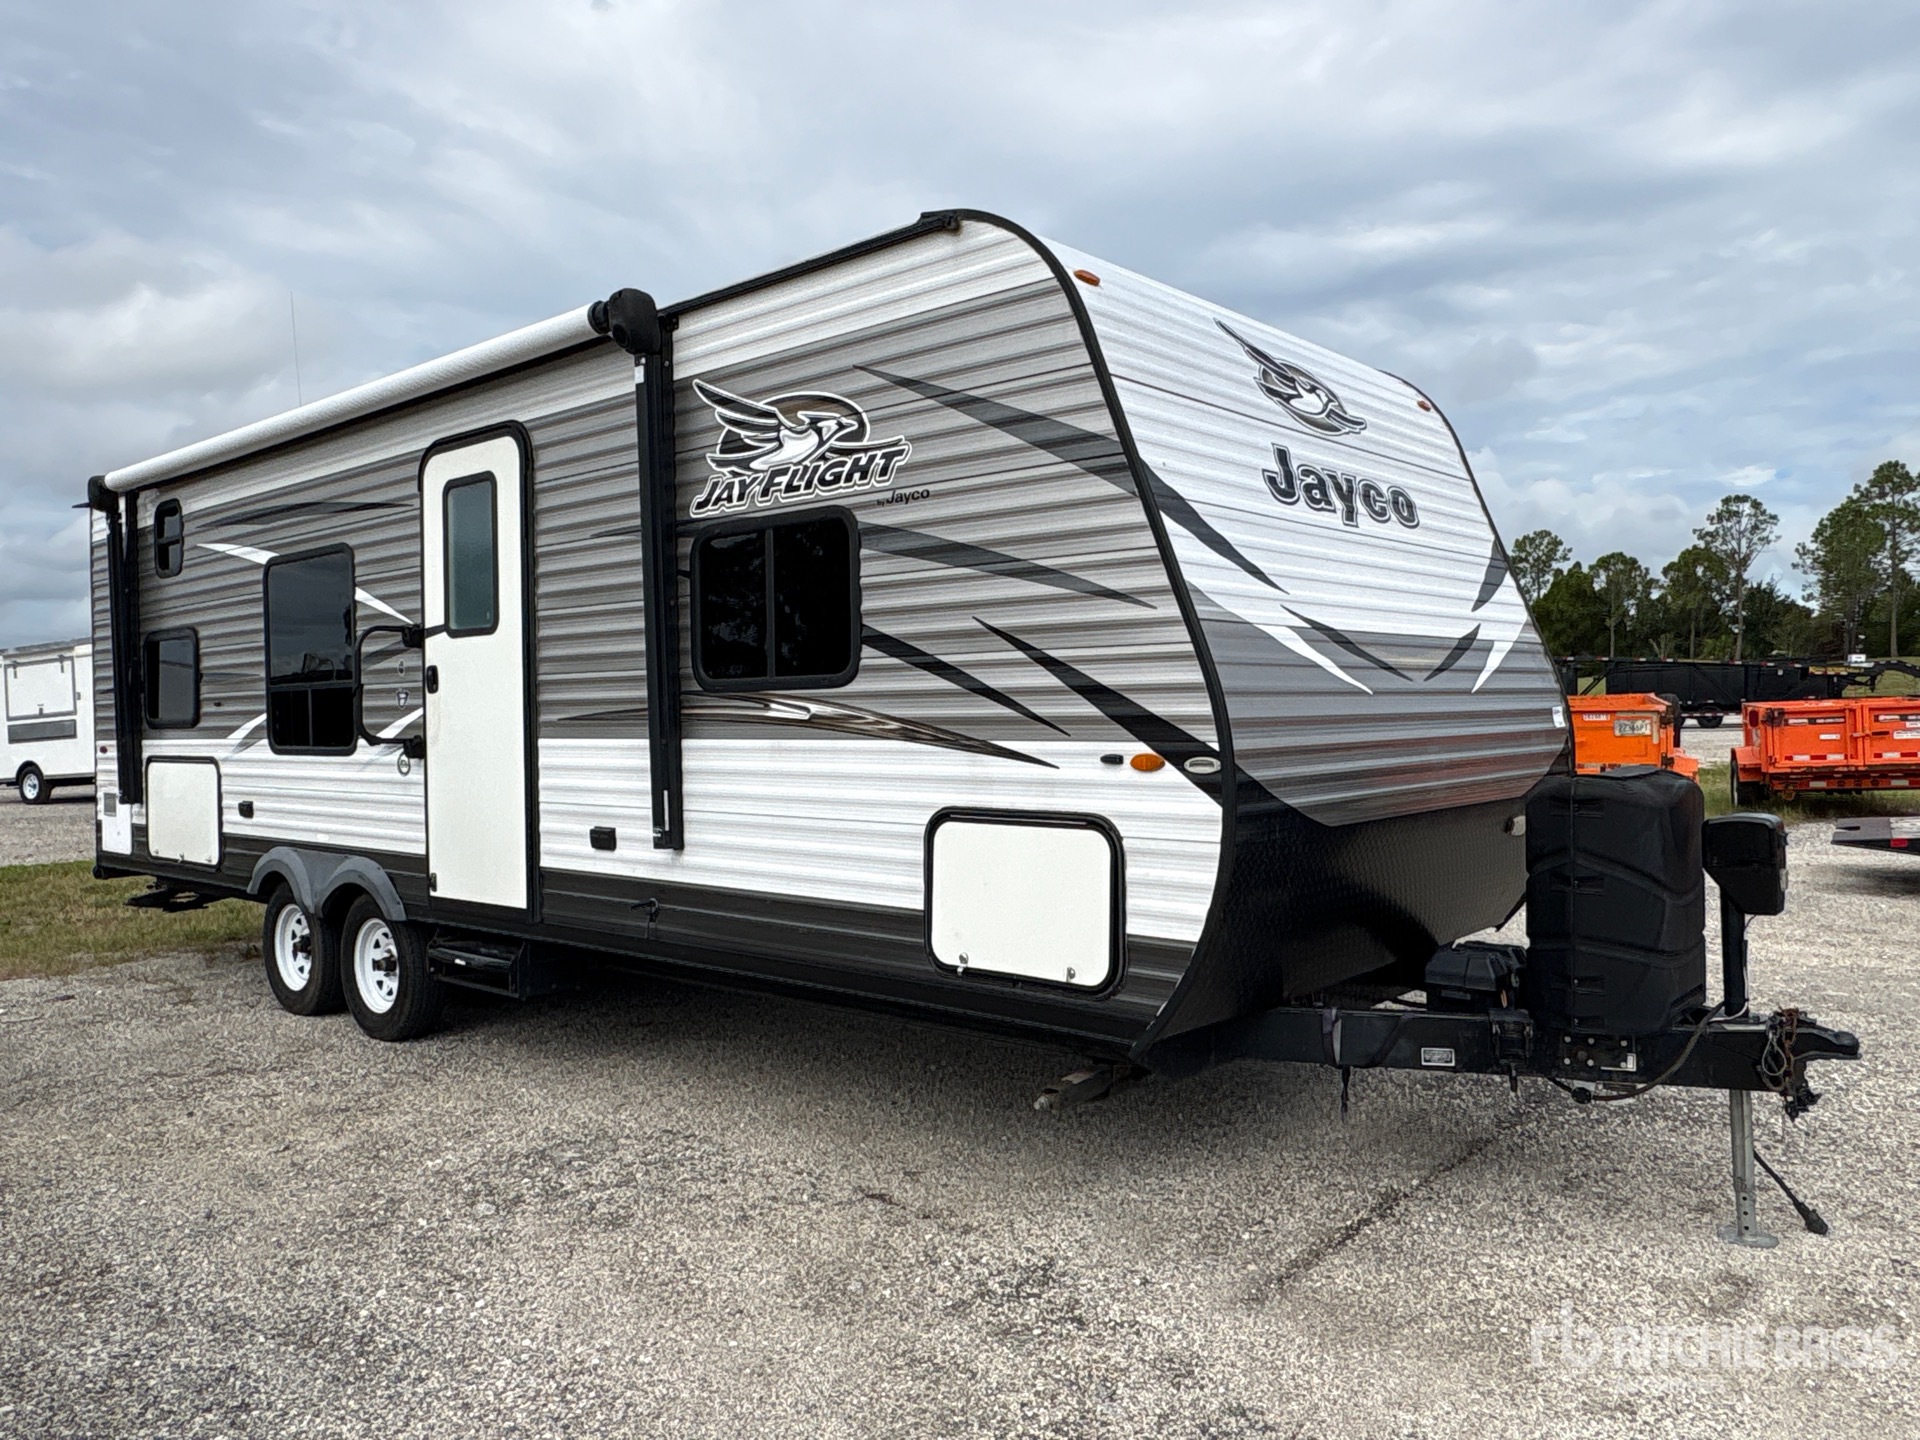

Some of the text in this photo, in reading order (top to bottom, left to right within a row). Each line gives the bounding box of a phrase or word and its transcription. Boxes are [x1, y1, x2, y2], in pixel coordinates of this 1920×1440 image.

[691, 444, 910, 516] JAY FLIGHT
[886, 489, 930, 504] Jayco
[1262, 443, 1420, 528] Jayco
